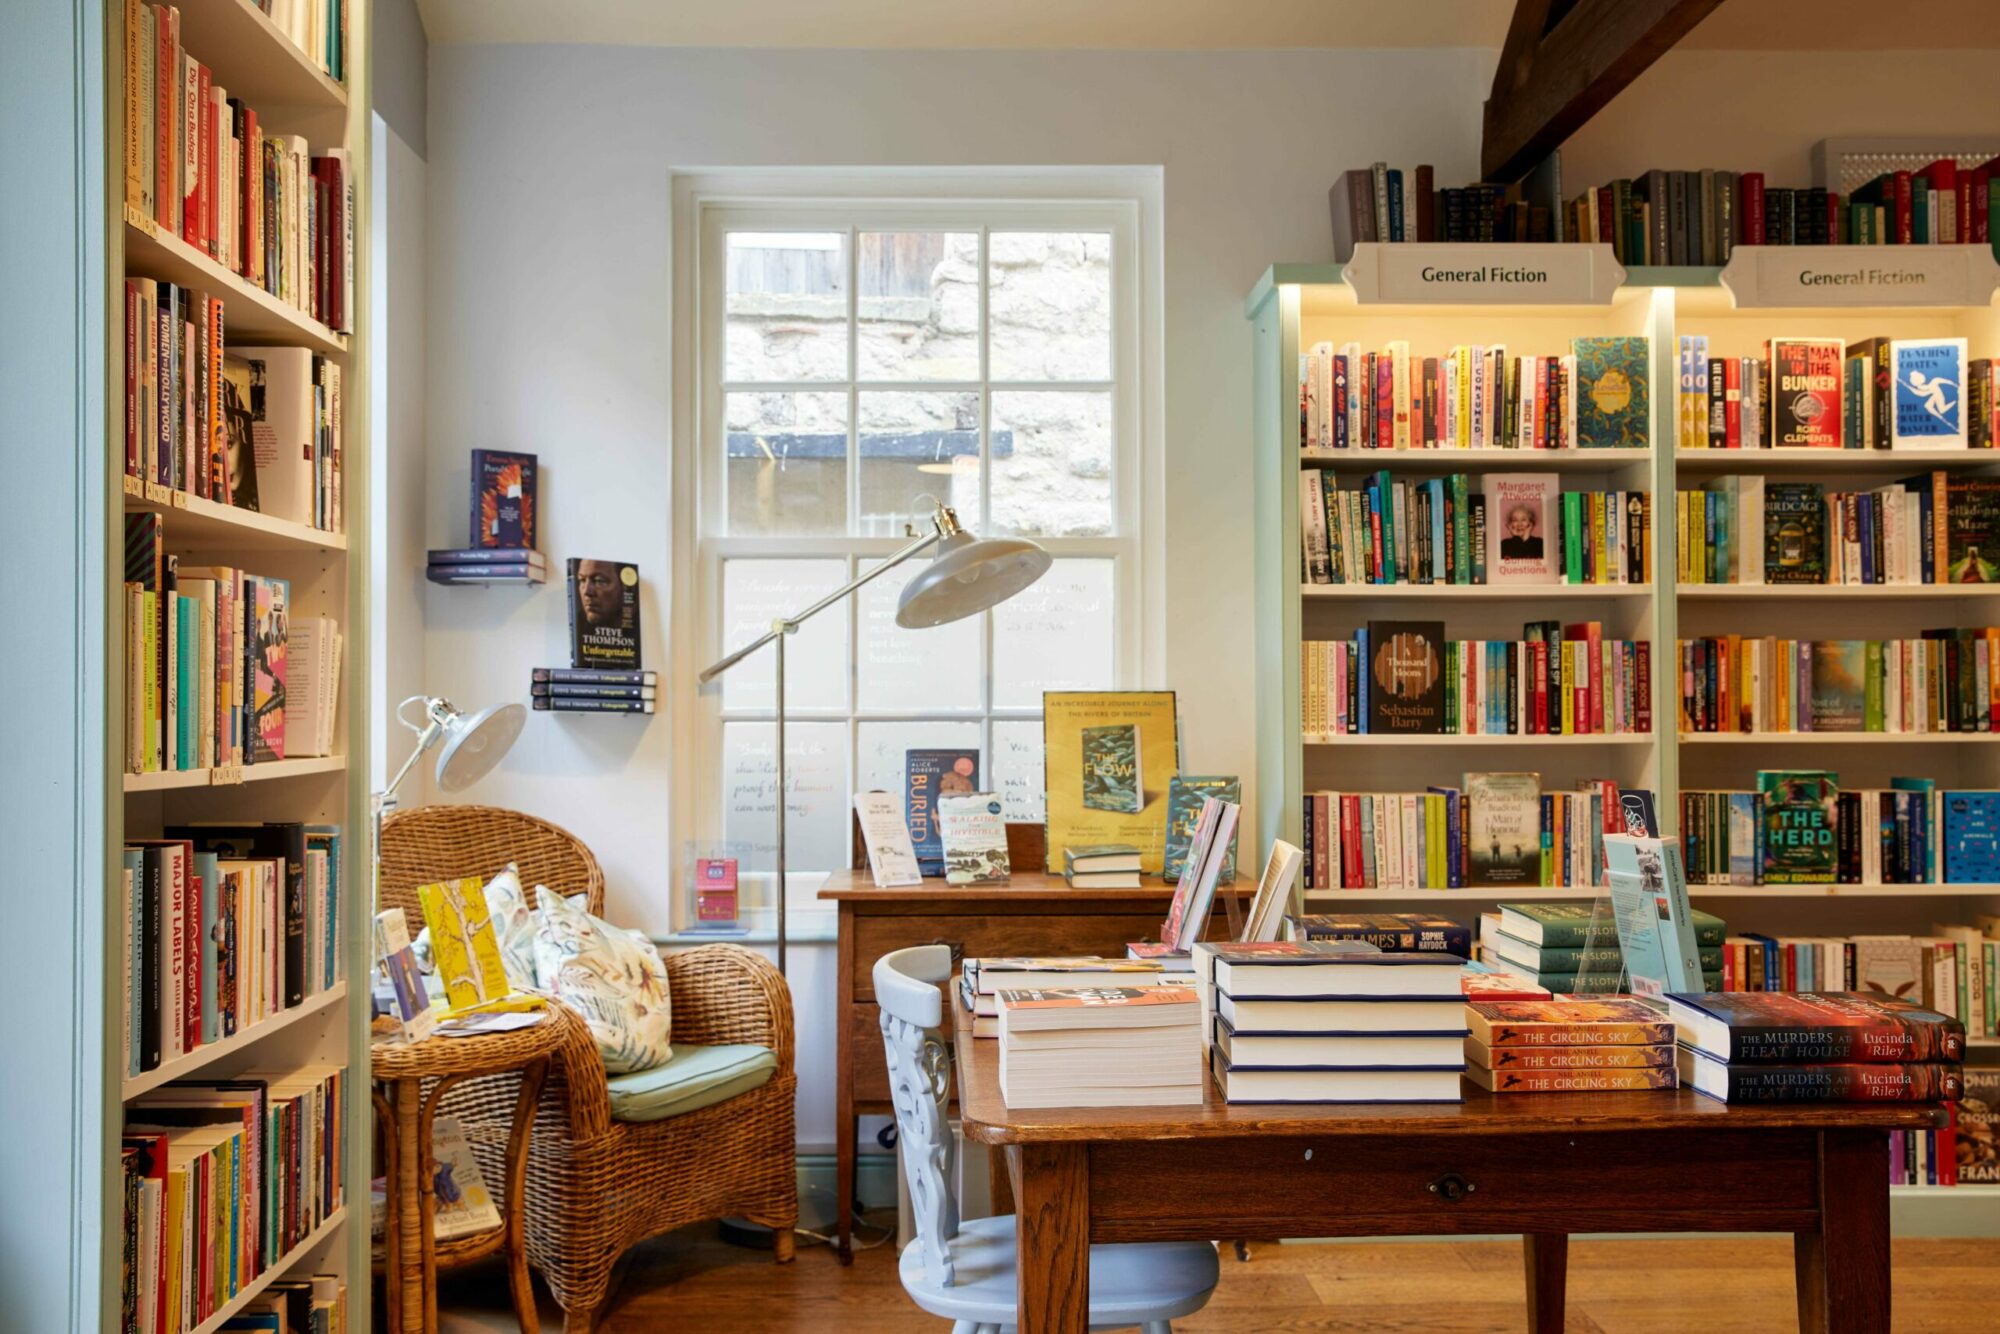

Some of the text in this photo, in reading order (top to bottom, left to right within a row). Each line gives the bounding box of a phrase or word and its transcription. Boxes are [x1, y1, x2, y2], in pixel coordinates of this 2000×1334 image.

[188, 67, 197, 88] Diy
[188, 91, 197, 108] On
[188, 121, 197, 165] Budget
[1421, 264, 1544, 282] General Fiction
[1788, 266, 1912, 285] General Fiction
[161, 314, 170, 358] WOMEN
[1779, 345, 1840, 362] THE MAN
[1791, 361, 1832, 376] IN THE
[1899, 360, 1938, 369] COATES
[1712, 363, 1721, 397] LEE CHILD
[1781, 375, 1837, 391] BUNKER
[162, 368, 170, 442] HOLLYWOOD
[1900, 404, 1918, 412] THE
[1524, 399, 1533, 424] BRICK
[1900, 414, 1932, 423] WATER
[1795, 424, 1823, 434] RORY
[1899, 424, 1938, 433] DANCER
[1783, 434, 1834, 444] CLEMENTS
[1496, 482, 1546, 493] Margaret
[1309, 478, 1319, 522] MARTIN AMIS
[1502, 492, 1543, 502] Atwood
[1458, 518, 1466, 538] DANI
[1957, 518, 1989, 530] Maze
[1475, 506, 1484, 565] KATE ATKINSON
[1498, 566, 1548, 576] Questions
[595, 627, 623, 638] STEVE
[582, 635, 635, 646] THOMPSON
[582, 645, 636, 658] Unforgettable
[1386, 657, 1428, 668] Thousand
[1550, 630, 1560, 686] NORTHERN SPY
[1394, 669, 1422, 678] Moons
[1638, 653, 1648, 708] GUEST BOOK
[1379, 704, 1434, 716] Sebastian
[1391, 717, 1423, 730] Barry
[1096, 753, 1118, 763] THE
[1084, 763, 1132, 777] FLOW
[910, 774, 928, 842] BURIED
[1375, 800, 1383, 812] THE
[1778, 811, 1822, 828] THE
[1769, 829, 1832, 846] HERD
[1763, 873, 1836, 883] EMILY EDWARDS
[172, 855, 182, 975] MAJOR LABELS
[1421, 931, 1445, 941] SOPHIE
[1573, 927, 1589, 936] THE
[1342, 933, 1395, 948] FLAMES
[1419, 941, 1448, 951] HAYDOCK
[1571, 952, 1619, 961] THE SLOTH
[1570, 977, 1617, 986] THE SLOTH
[1523, 1032, 1630, 1043] THE CIRCLING SKY
[1740, 1035, 1761, 1044] THE
[1764, 1033, 1833, 1044] MURDERS
[1863, 1032, 1913, 1044] Lucinda
[1741, 1046, 1851, 1058] FLEAT HOUSE
[1872, 1045, 1905, 1058] Riley
[1523, 1055, 1630, 1067] THE CIRCLING SKY
[1528, 1077, 1633, 1089] THE CIRCLING SKY
[1739, 1076, 1758, 1086] THE
[1762, 1074, 1832, 1085] MURDERS
[1862, 1073, 1912, 1084] Lucinda
[1739, 1087, 1849, 1099] FLEAT HOUSE
[1871, 1086, 1904, 1099] Riley
